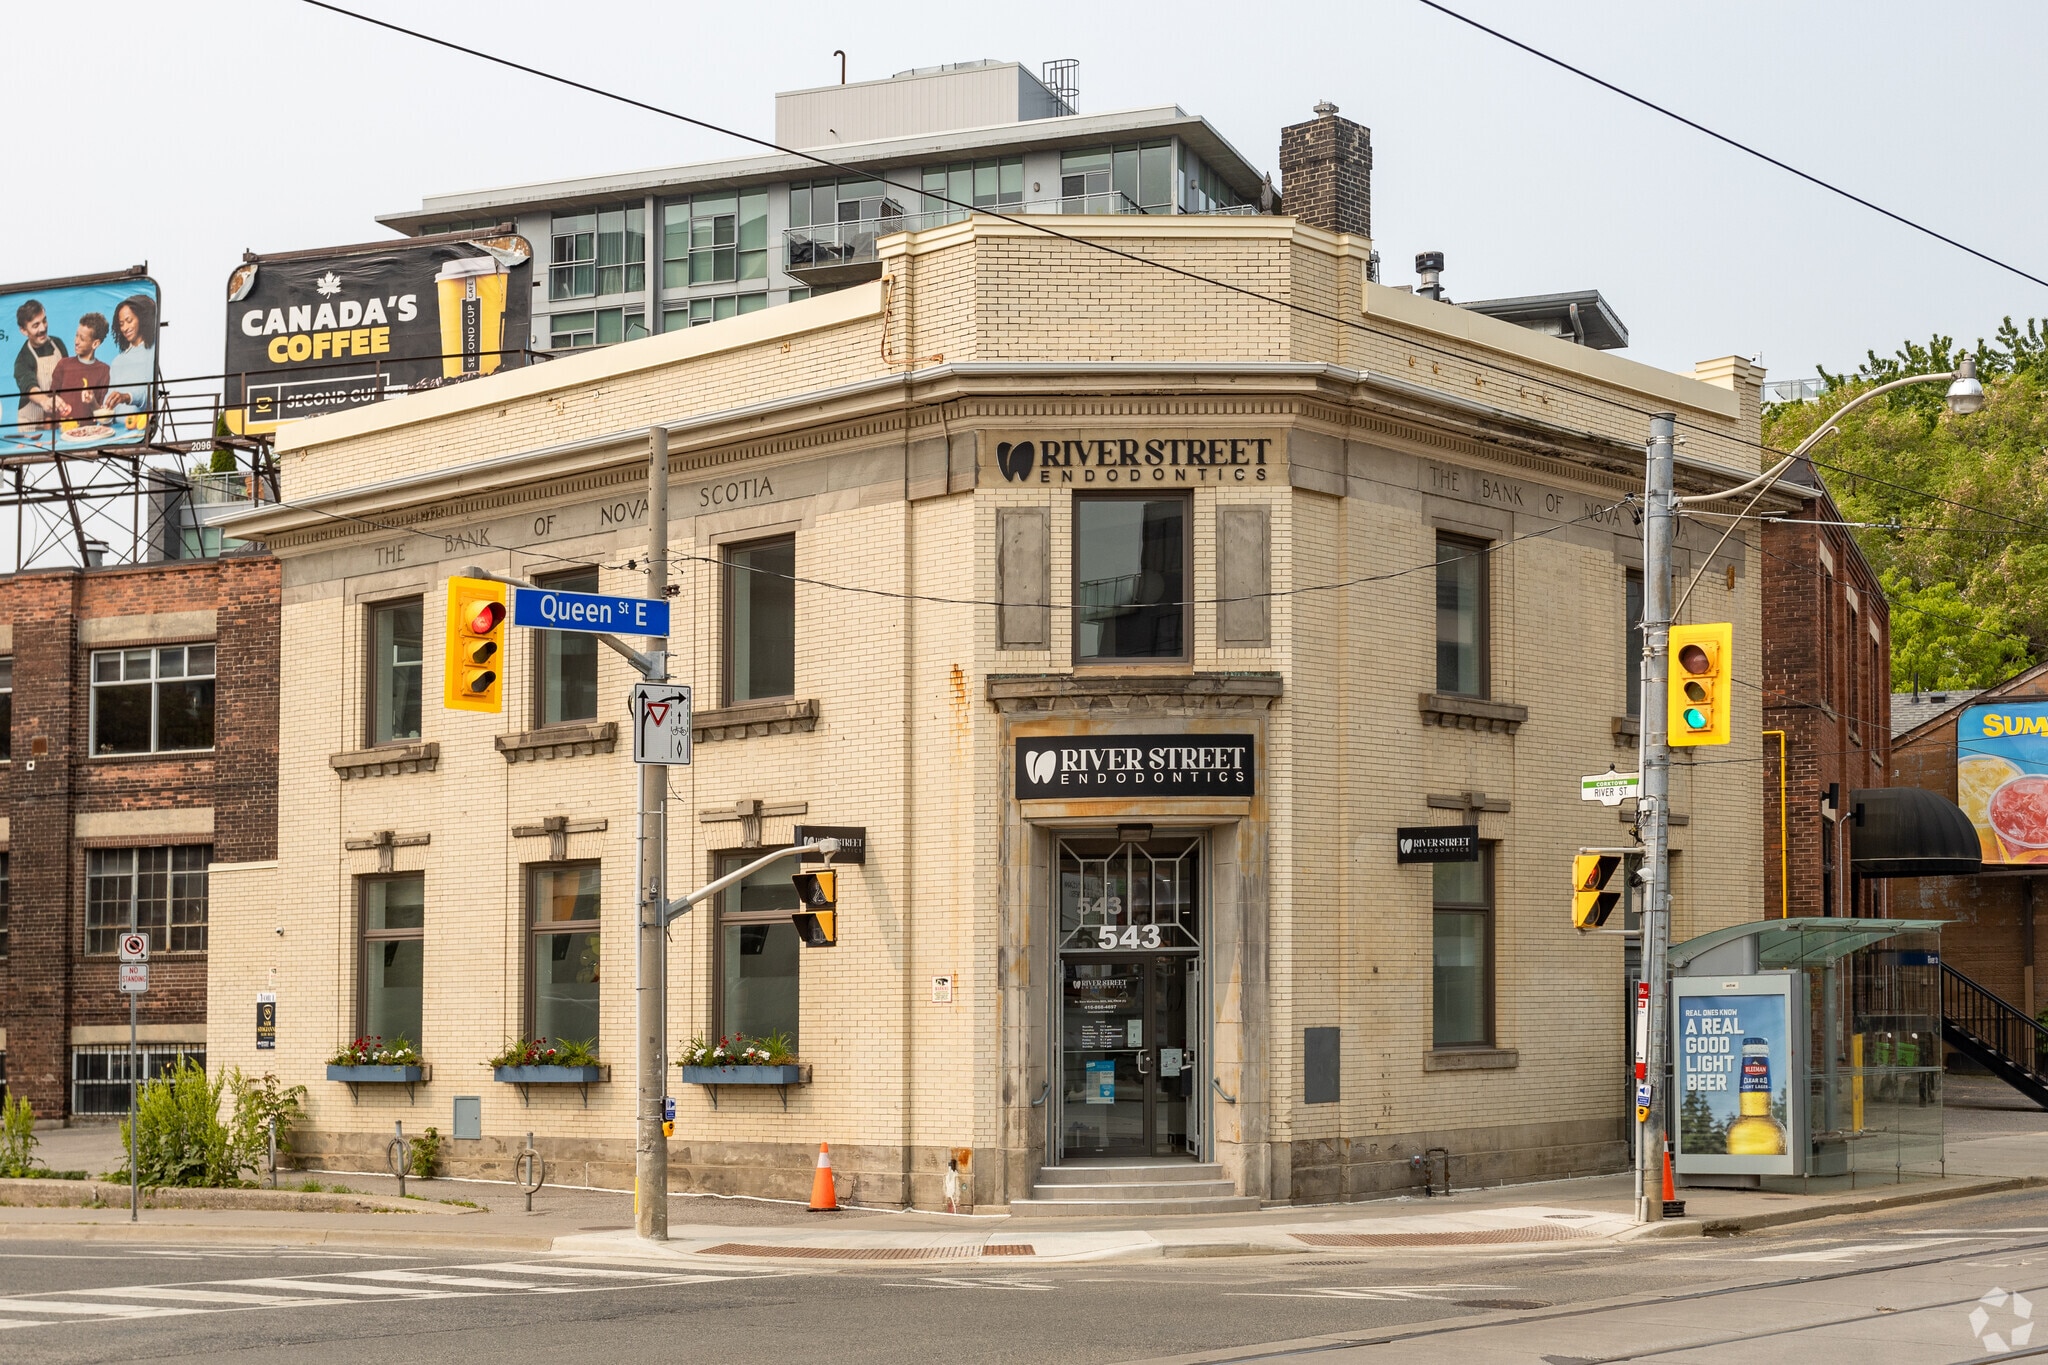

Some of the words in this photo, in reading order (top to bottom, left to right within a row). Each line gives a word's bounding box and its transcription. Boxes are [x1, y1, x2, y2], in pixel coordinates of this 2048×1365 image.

[241, 294, 418, 337] CANADA'S
[467, 304, 475, 325] CUP
[268, 326, 390, 363] COFFEE
[286, 390, 347, 408] SECOND
[191, 440, 211, 451] 2096
[1040, 439, 1142, 467] RIVER
[1145, 438, 1272, 466] STREET
[1040, 468, 1267, 483] ENDODONTICS
[1429, 466, 1459, 492] THE
[1482, 478, 1524, 506] BANK
[1545, 493, 1564, 514] OF
[1584, 502, 1622, 527] NOVA
[375, 543, 405, 566] THE
[444, 527, 491, 553] BANK
[534, 515, 556, 536] OF
[700, 476, 774, 507] SCOTIA
[540, 594, 612, 624] Queen
[618, 601, 629, 614] St
[635, 602, 647, 626] E
[1060, 749, 1144, 772] RIVER
[1149, 747, 1246, 770] STREET
[1060, 771, 1245, 785] ENDODONTICS
[1594, 788, 1614, 797] RIVER
[1413, 838, 1438, 848] RIVER
[1439, 837, 1471, 847] STREET
[1098, 924, 1161, 950] 543
[122, 975, 147, 983] STANDING
[1685, 1018, 1698, 1035] A
[1701, 1017, 1745, 1035] REAL
[1685, 1036, 1730, 1054] GOOD
[1686, 1055, 1735, 1072] LIGHT
[1686, 1073, 1727, 1091] BEER
